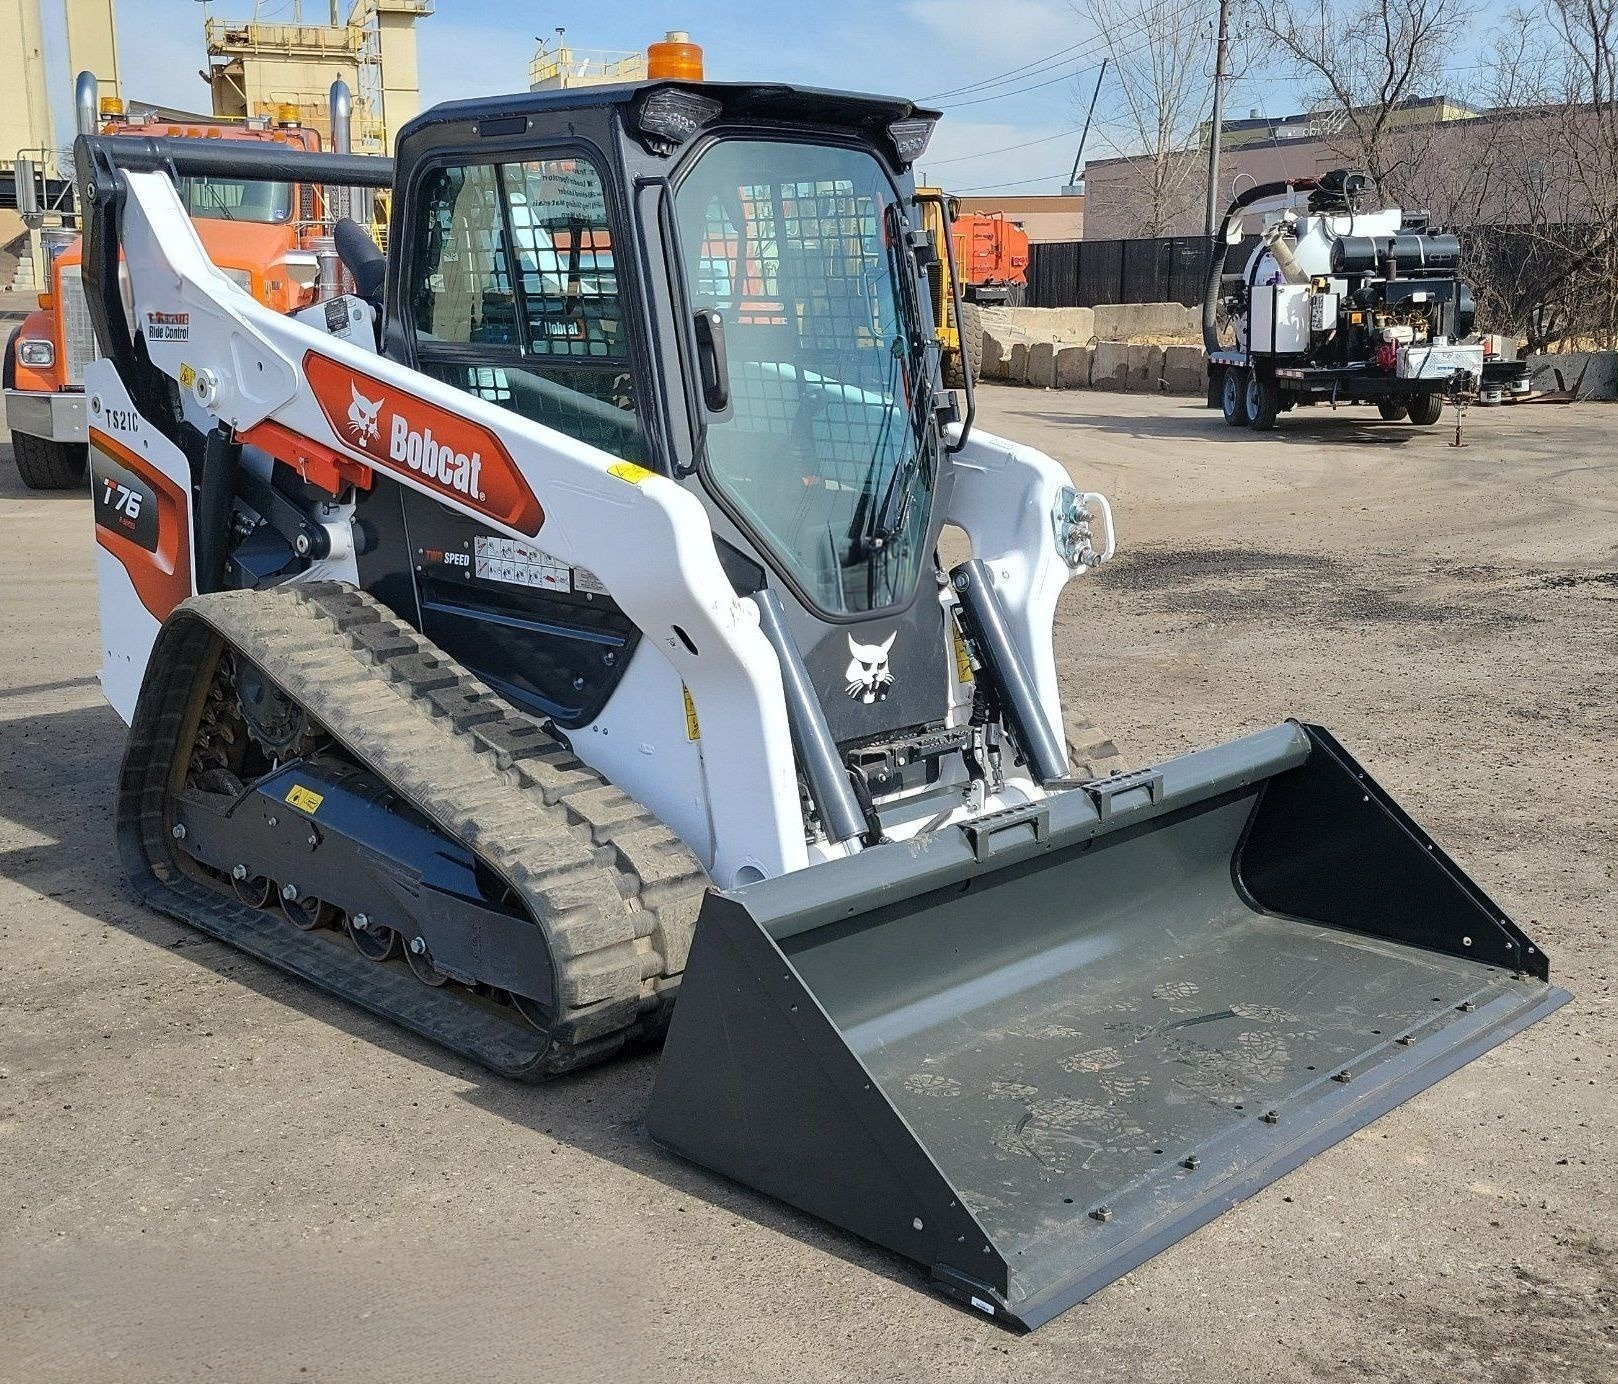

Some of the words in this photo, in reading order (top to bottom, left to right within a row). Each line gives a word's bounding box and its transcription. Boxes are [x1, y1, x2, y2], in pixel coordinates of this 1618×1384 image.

[149, 325, 164, 339] Ride
[165, 325, 189, 340] Control
[105, 409, 139, 433] TS21C
[390, 413, 483, 500] Bobcat
[103, 477, 143, 519] T76
[444, 552, 470, 567] SPEED
